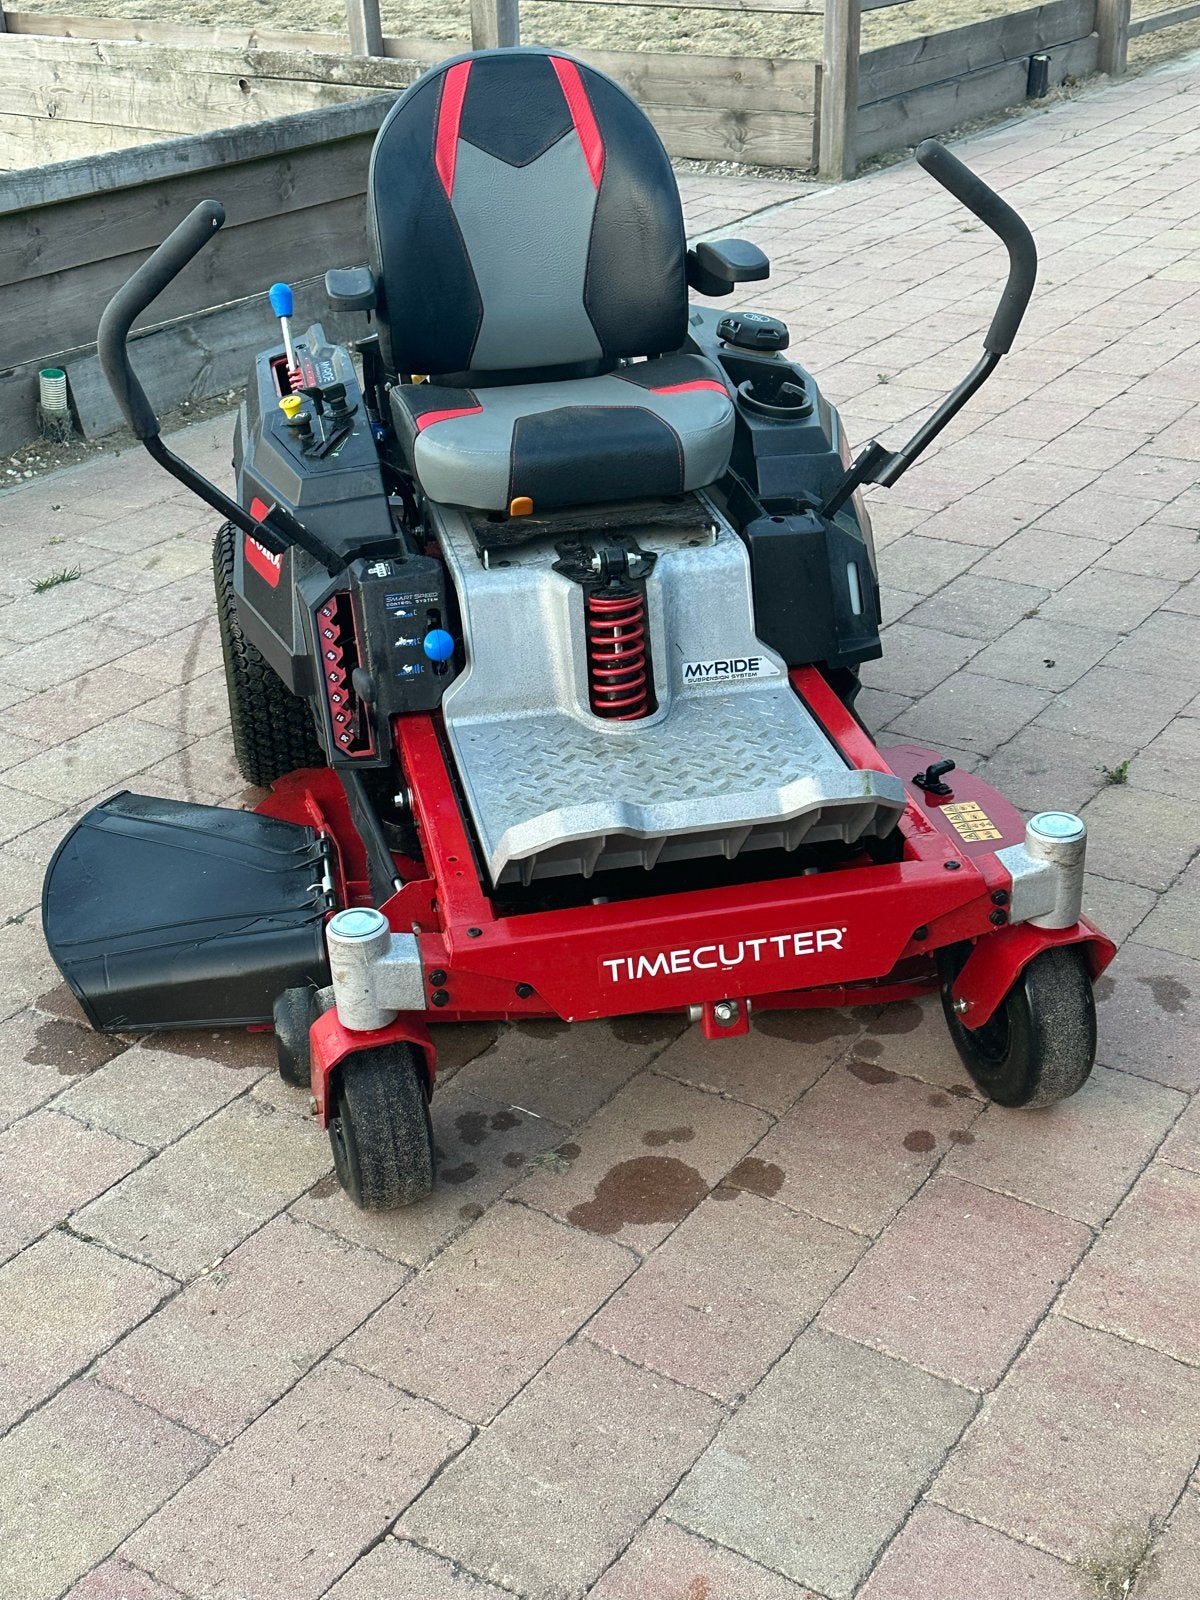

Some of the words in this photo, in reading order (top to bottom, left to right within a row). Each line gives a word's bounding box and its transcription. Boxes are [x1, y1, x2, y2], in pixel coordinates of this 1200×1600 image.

[386, 594, 413, 603] SMART
[688, 675, 729, 683] SUSPENSION
[603, 928, 844, 982] TIMECUTTER
